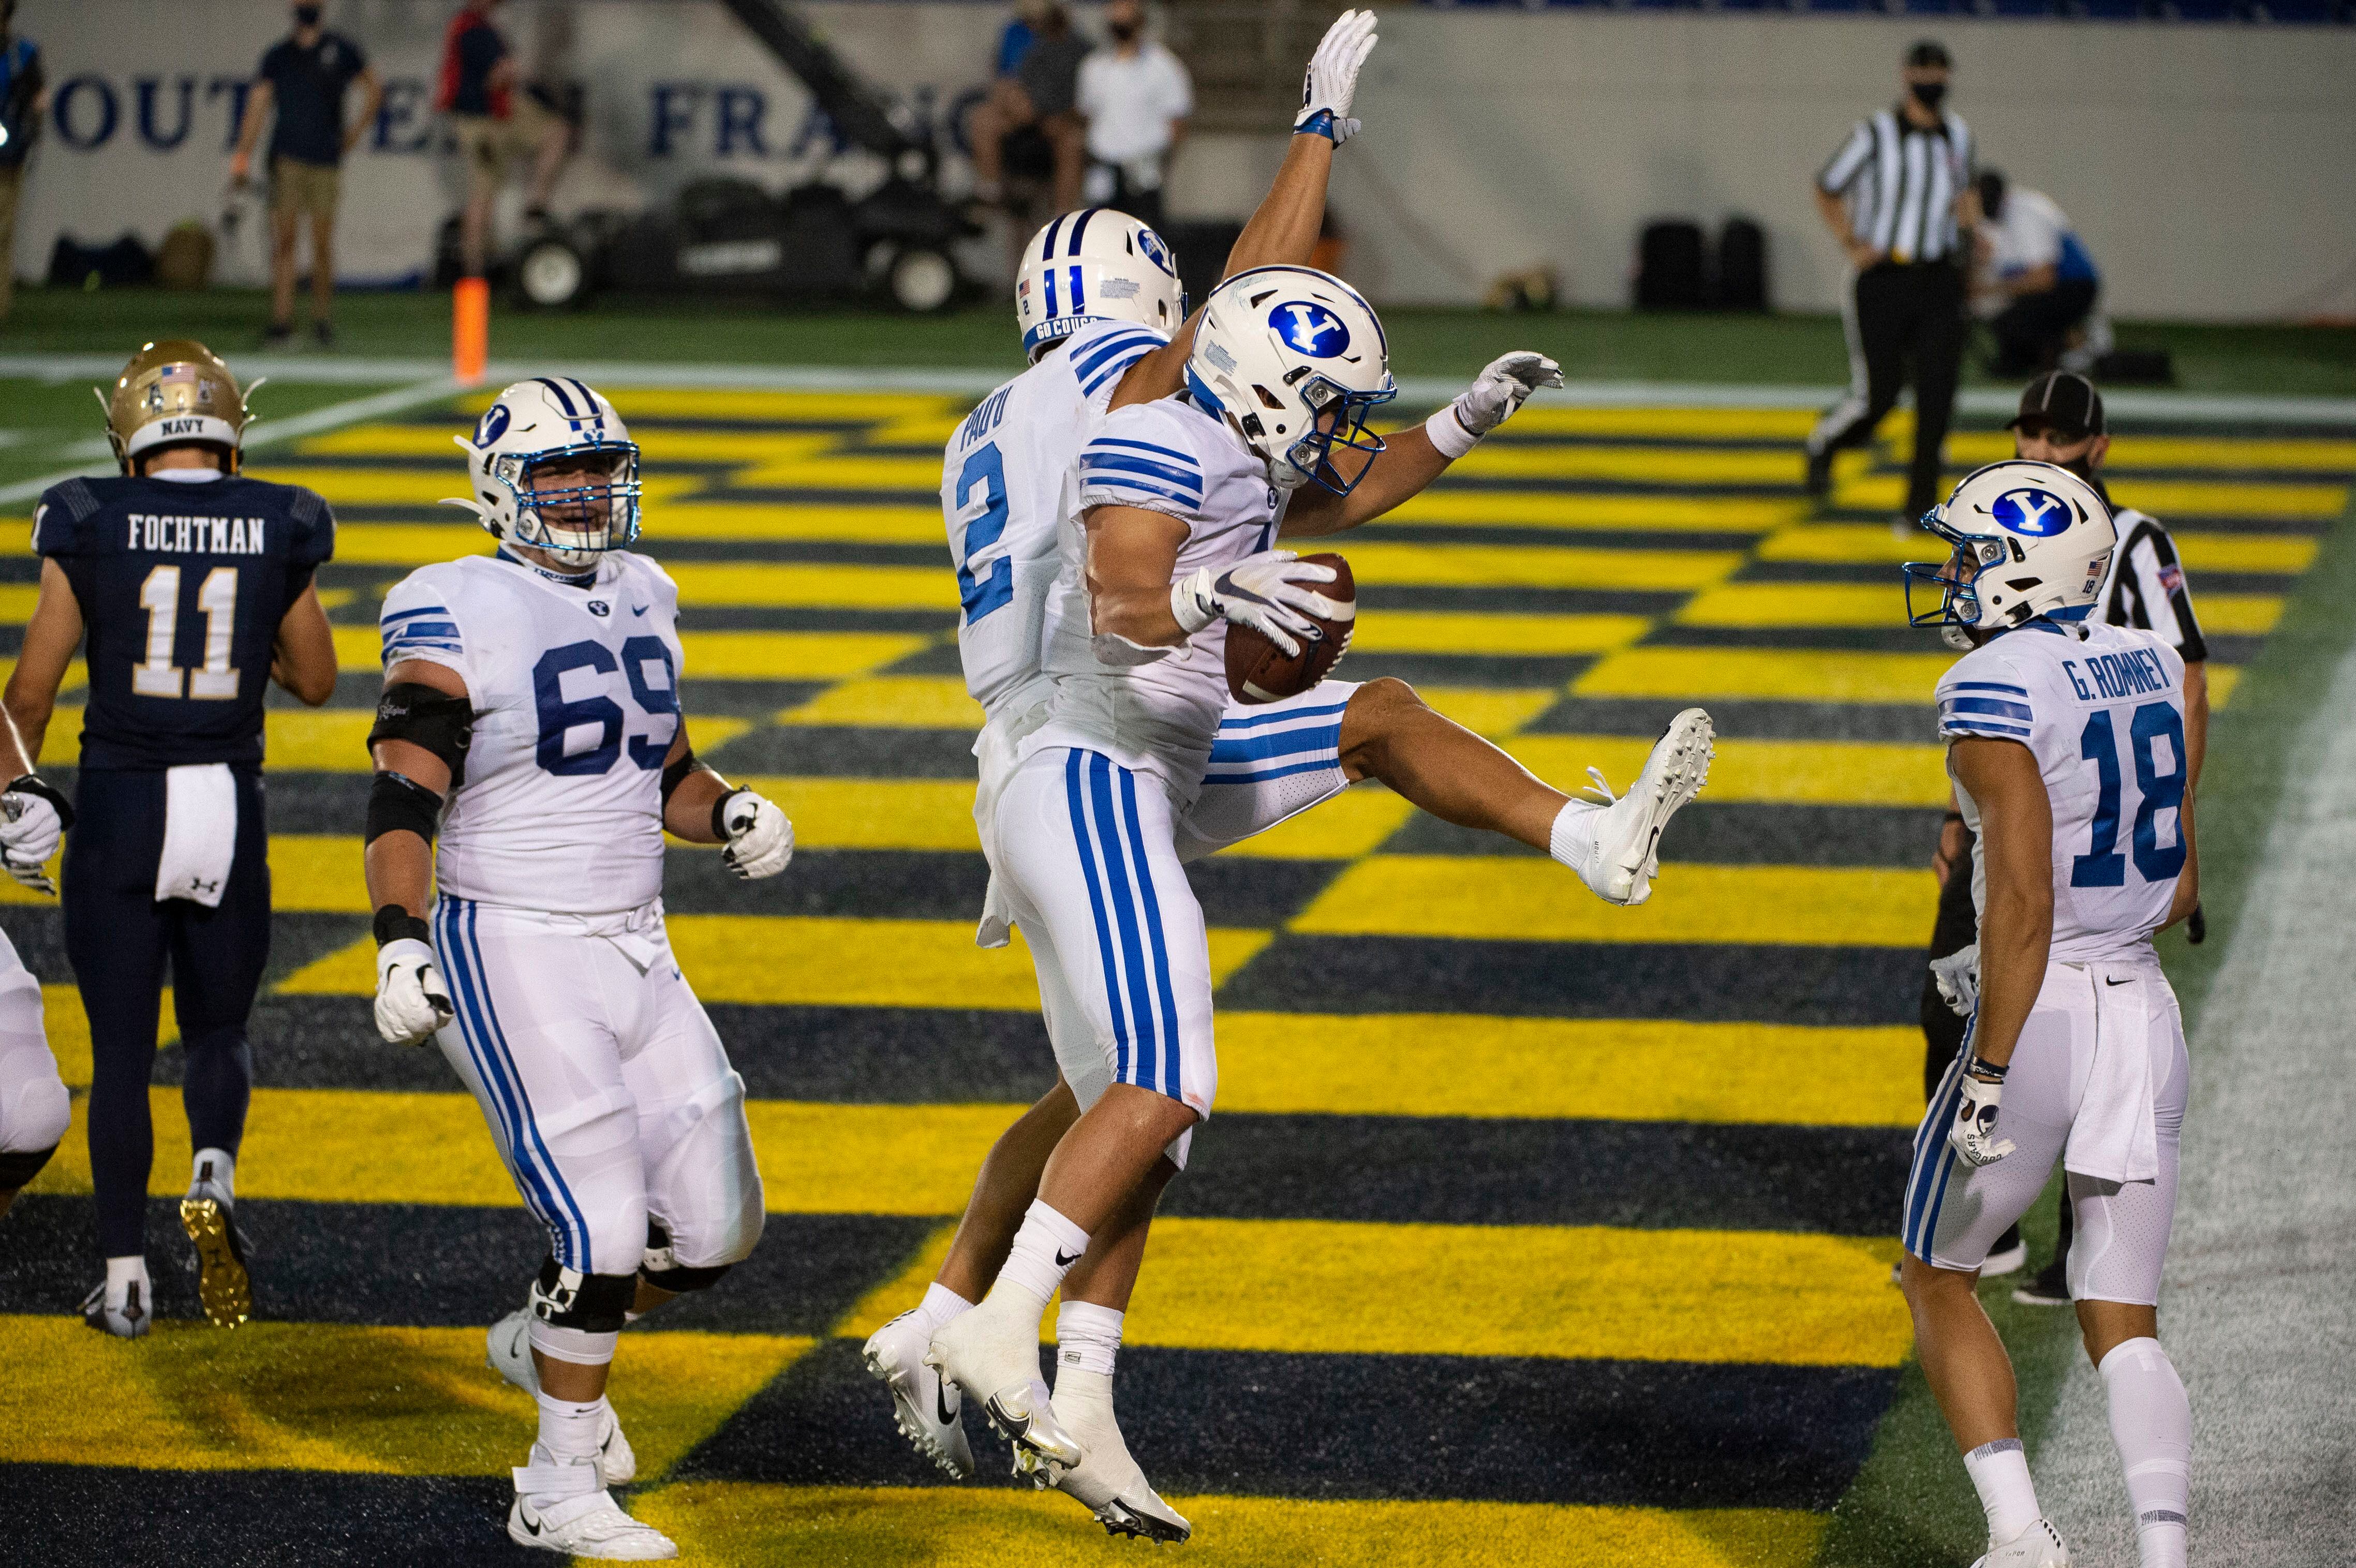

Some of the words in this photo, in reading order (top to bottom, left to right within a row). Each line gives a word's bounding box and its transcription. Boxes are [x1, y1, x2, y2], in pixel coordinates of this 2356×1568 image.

[1023, 300, 1030, 316] 2
[1285, 305, 1341, 351] Y
[1036, 322, 1052, 340] GO
[161, 418, 203, 436] NAVY
[2005, 491, 2062, 532] Y
[128, 513, 265, 555] FOCHTMAN
[957, 440, 1014, 626] 2
[2082, 580, 2096, 594] 18
[132, 564, 241, 701] 11
[532, 635, 681, 777] 69
[2070, 700, 2187, 887] 18
[1967, 1133, 2002, 1162] COUGARS
